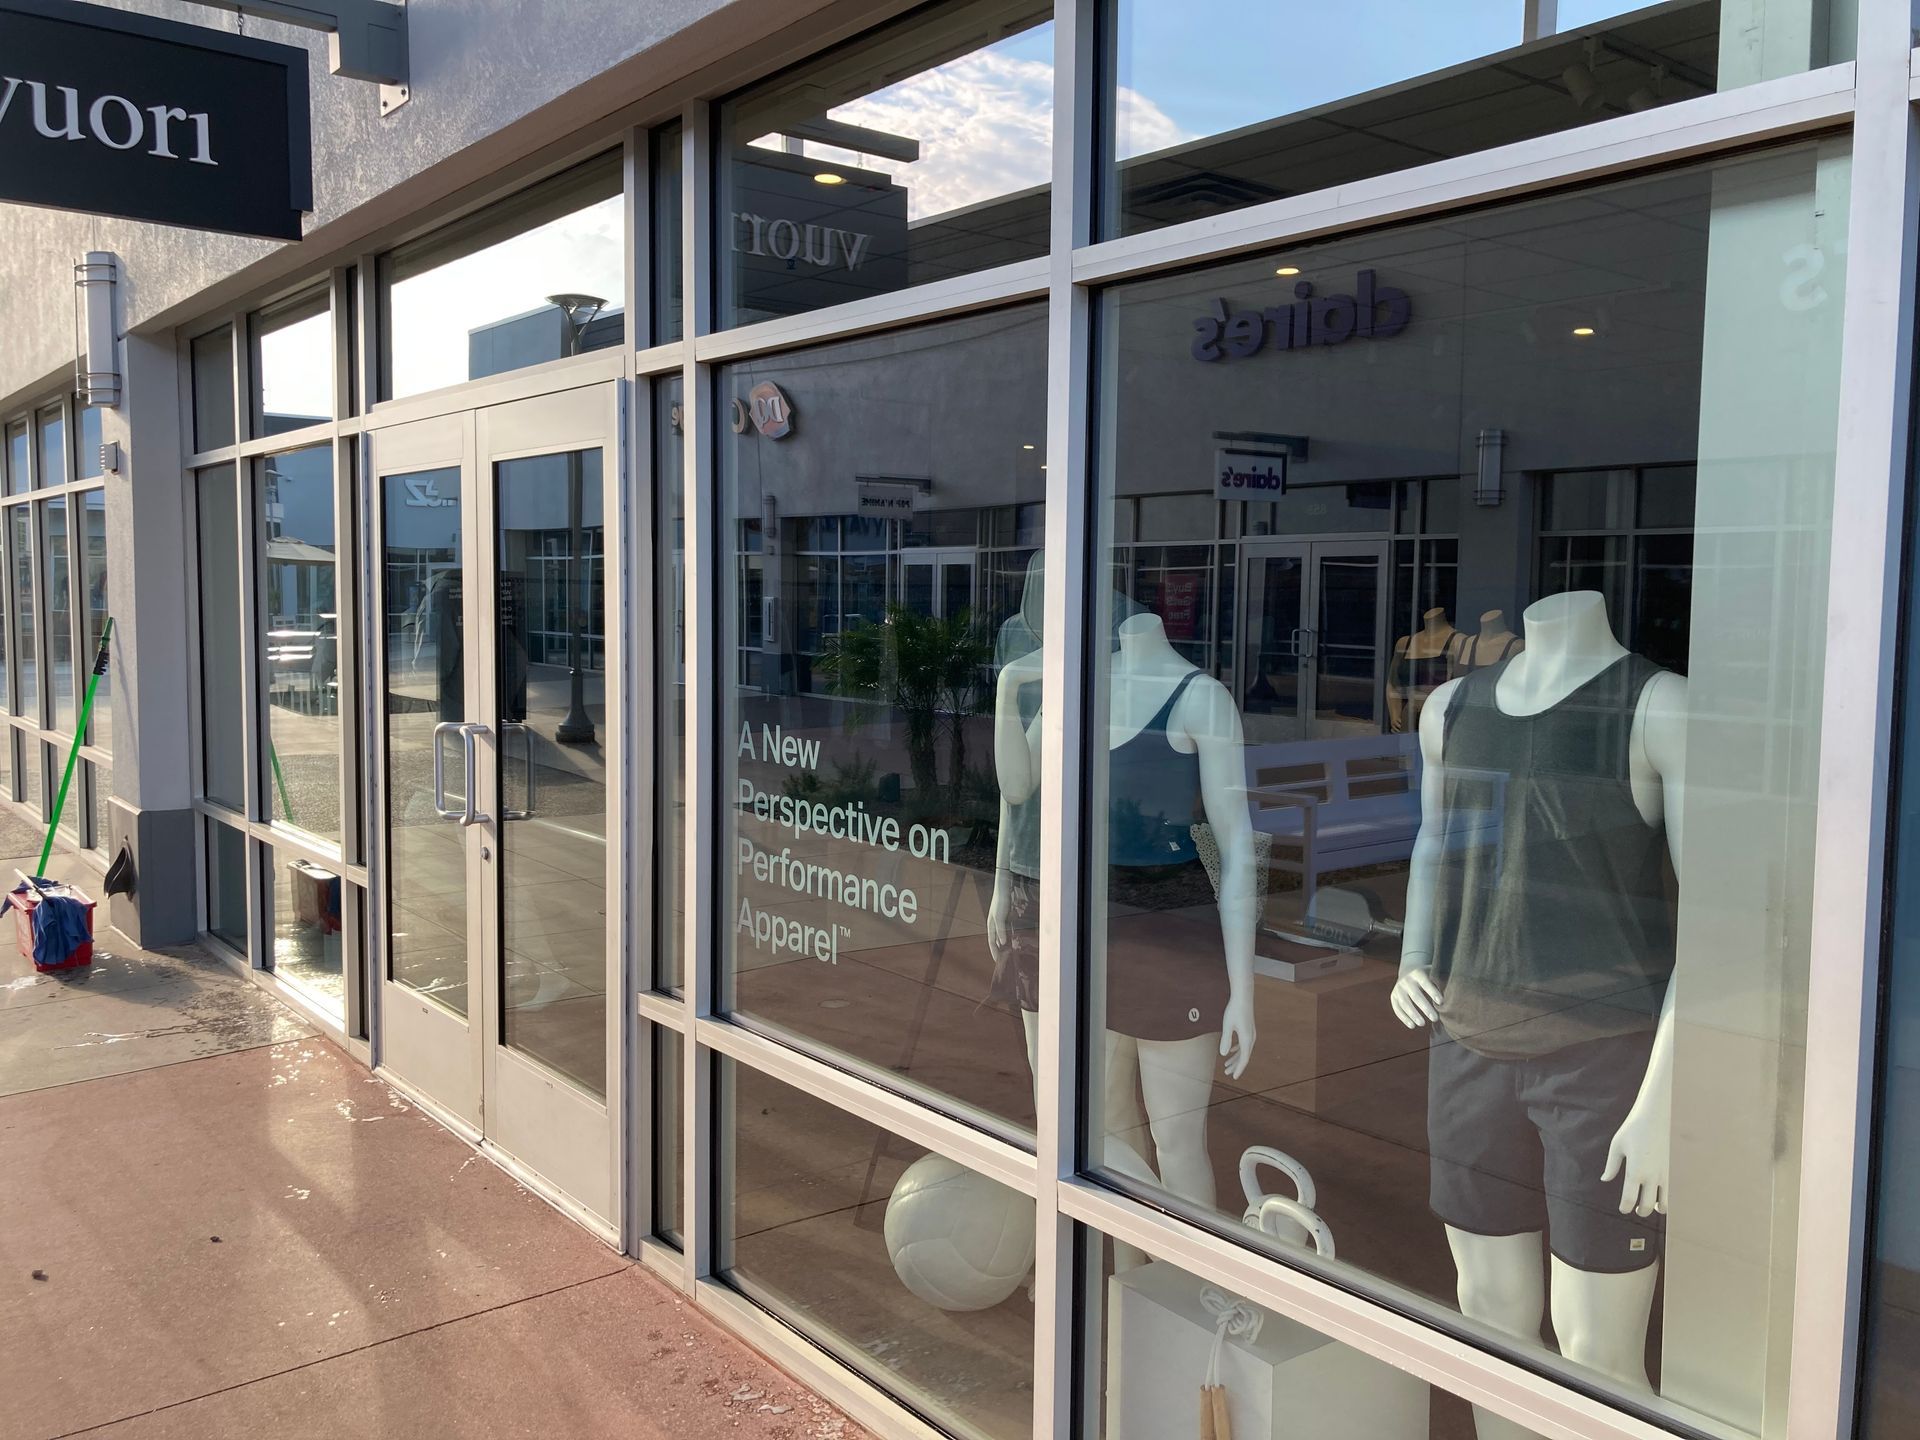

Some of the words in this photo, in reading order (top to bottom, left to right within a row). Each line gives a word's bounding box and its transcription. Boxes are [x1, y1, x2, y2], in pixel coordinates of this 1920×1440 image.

[738, 720, 756, 760] A
[762, 723, 821, 770] New
[738, 778, 900, 851] Perspective
[909, 823, 949, 864] on
[738, 837, 918, 924] Performance
